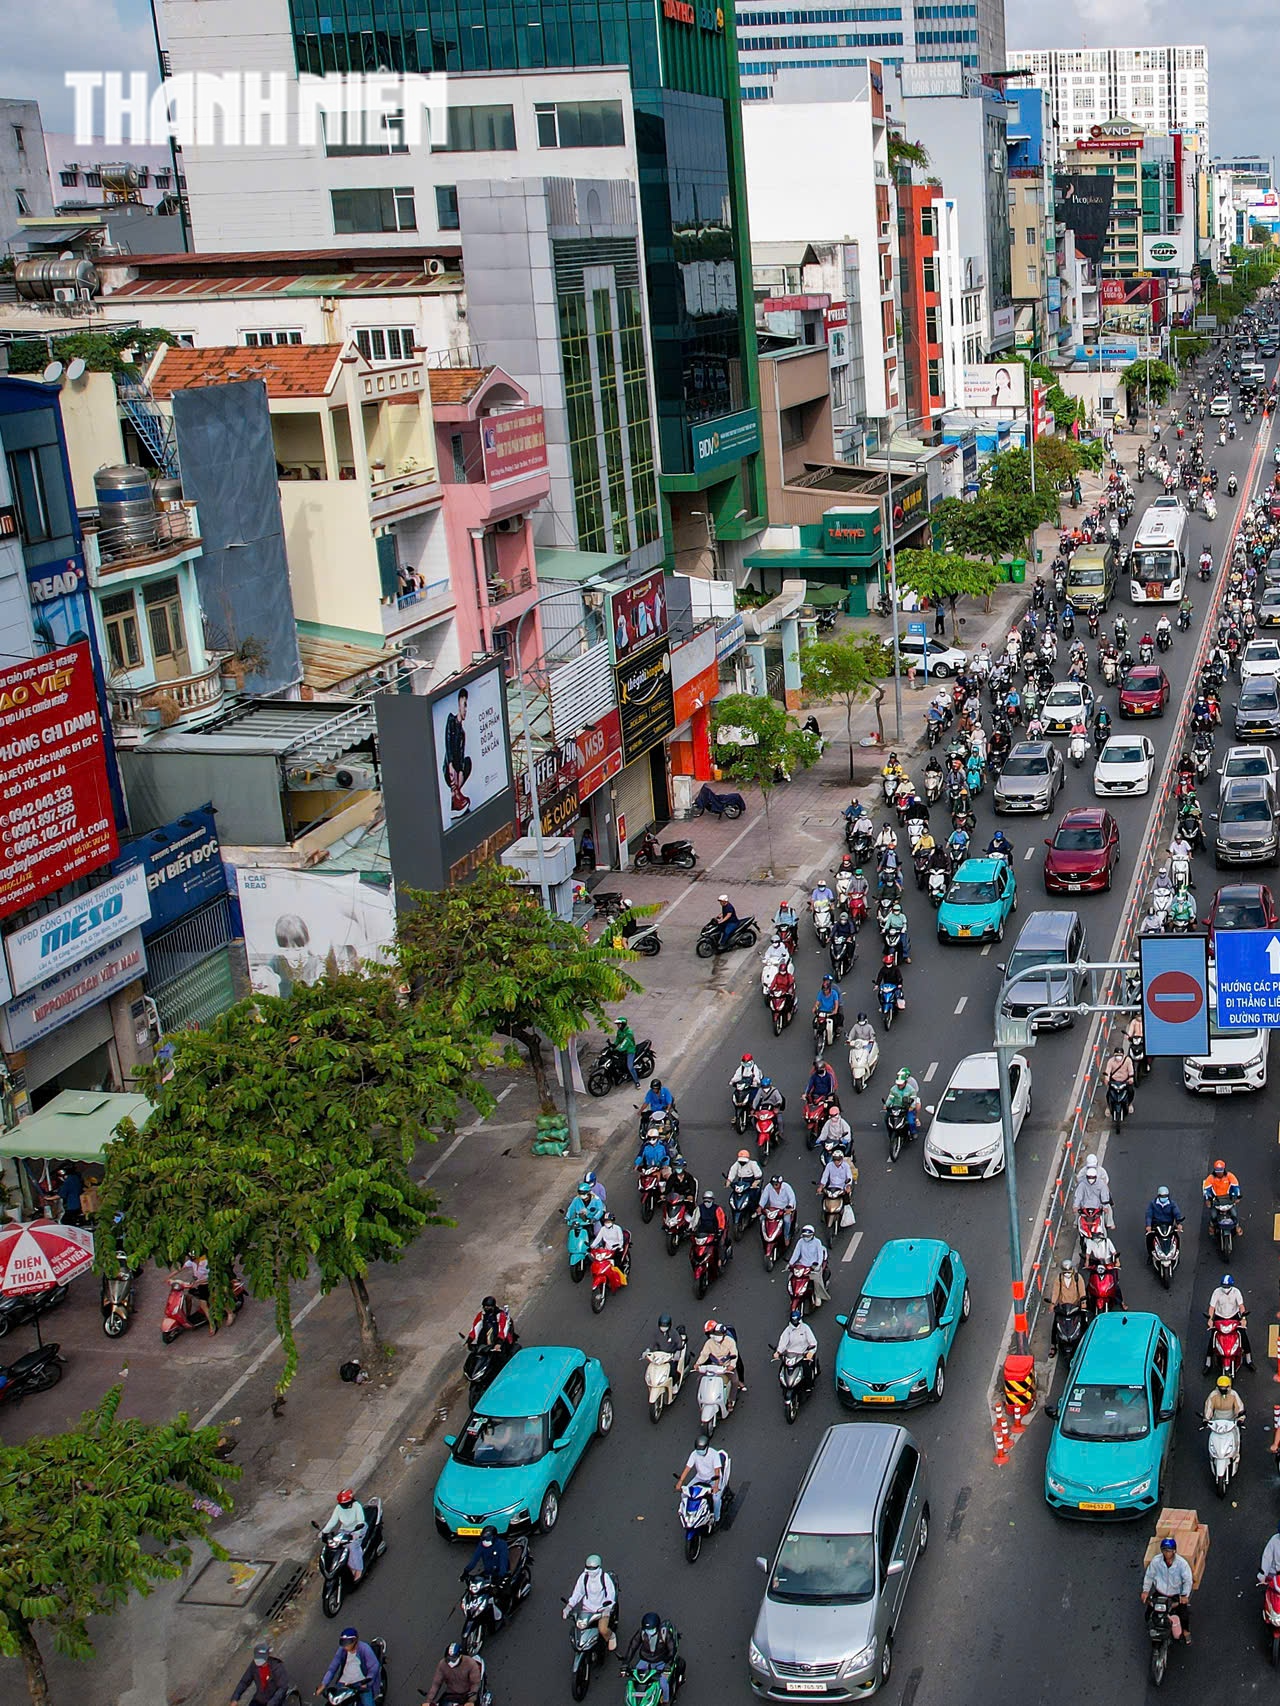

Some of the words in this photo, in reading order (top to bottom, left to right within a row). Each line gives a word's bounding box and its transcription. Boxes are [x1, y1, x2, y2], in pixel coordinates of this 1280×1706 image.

[904, 65, 925, 79] FOR
[930, 64, 958, 78] RENT
[699, 435, 715, 459] BIDV
[30, 571, 78, 603] READ
[31, 667, 74, 696] VIỆT
[42, 723, 63, 744] GHI
[64, 710, 97, 737] DANH
[34, 753, 50, 768] CÁC
[49, 745, 71, 764] HẠNG
[72, 741, 82, 753] B1
[82, 737, 93, 748] B2
[92, 733, 99, 743] C
[585, 731, 605, 761] MSB
[524, 757, 557, 795] BFFET
[9, 785, 73, 823] 0942.048.333
[11, 800, 75, 839] 0901.897.555
[14, 815, 77, 855] 0966.102.777
[146, 868, 166, 892] EM
[166, 851, 193, 879] BIẾT
[192, 839, 219, 864] ĐỌC
[39, 912, 62, 934] CÔNG
[62, 907, 74, 921] TY
[73, 898, 94, 915] TNHH
[94, 881, 125, 903] THƯƠNG
[126, 873, 139, 891] MẠI
[120, 951, 140, 972] NAM
[1221, 979, 1252, 994] HƯỚNG
[1253, 979, 1272, 993] CÁC
[1226, 997, 1236, 1008] ĐI
[1236, 993, 1267, 1008] THẲNG
[1229, 1011, 1261, 1024] ĐƯỜNG
[14, 1256, 42, 1270] ĐIỆN
[52, 1258, 72, 1274] GIÁO
[69, 1247, 89, 1265] VIÊN
[10, 1269, 47, 1285] THOẠI
